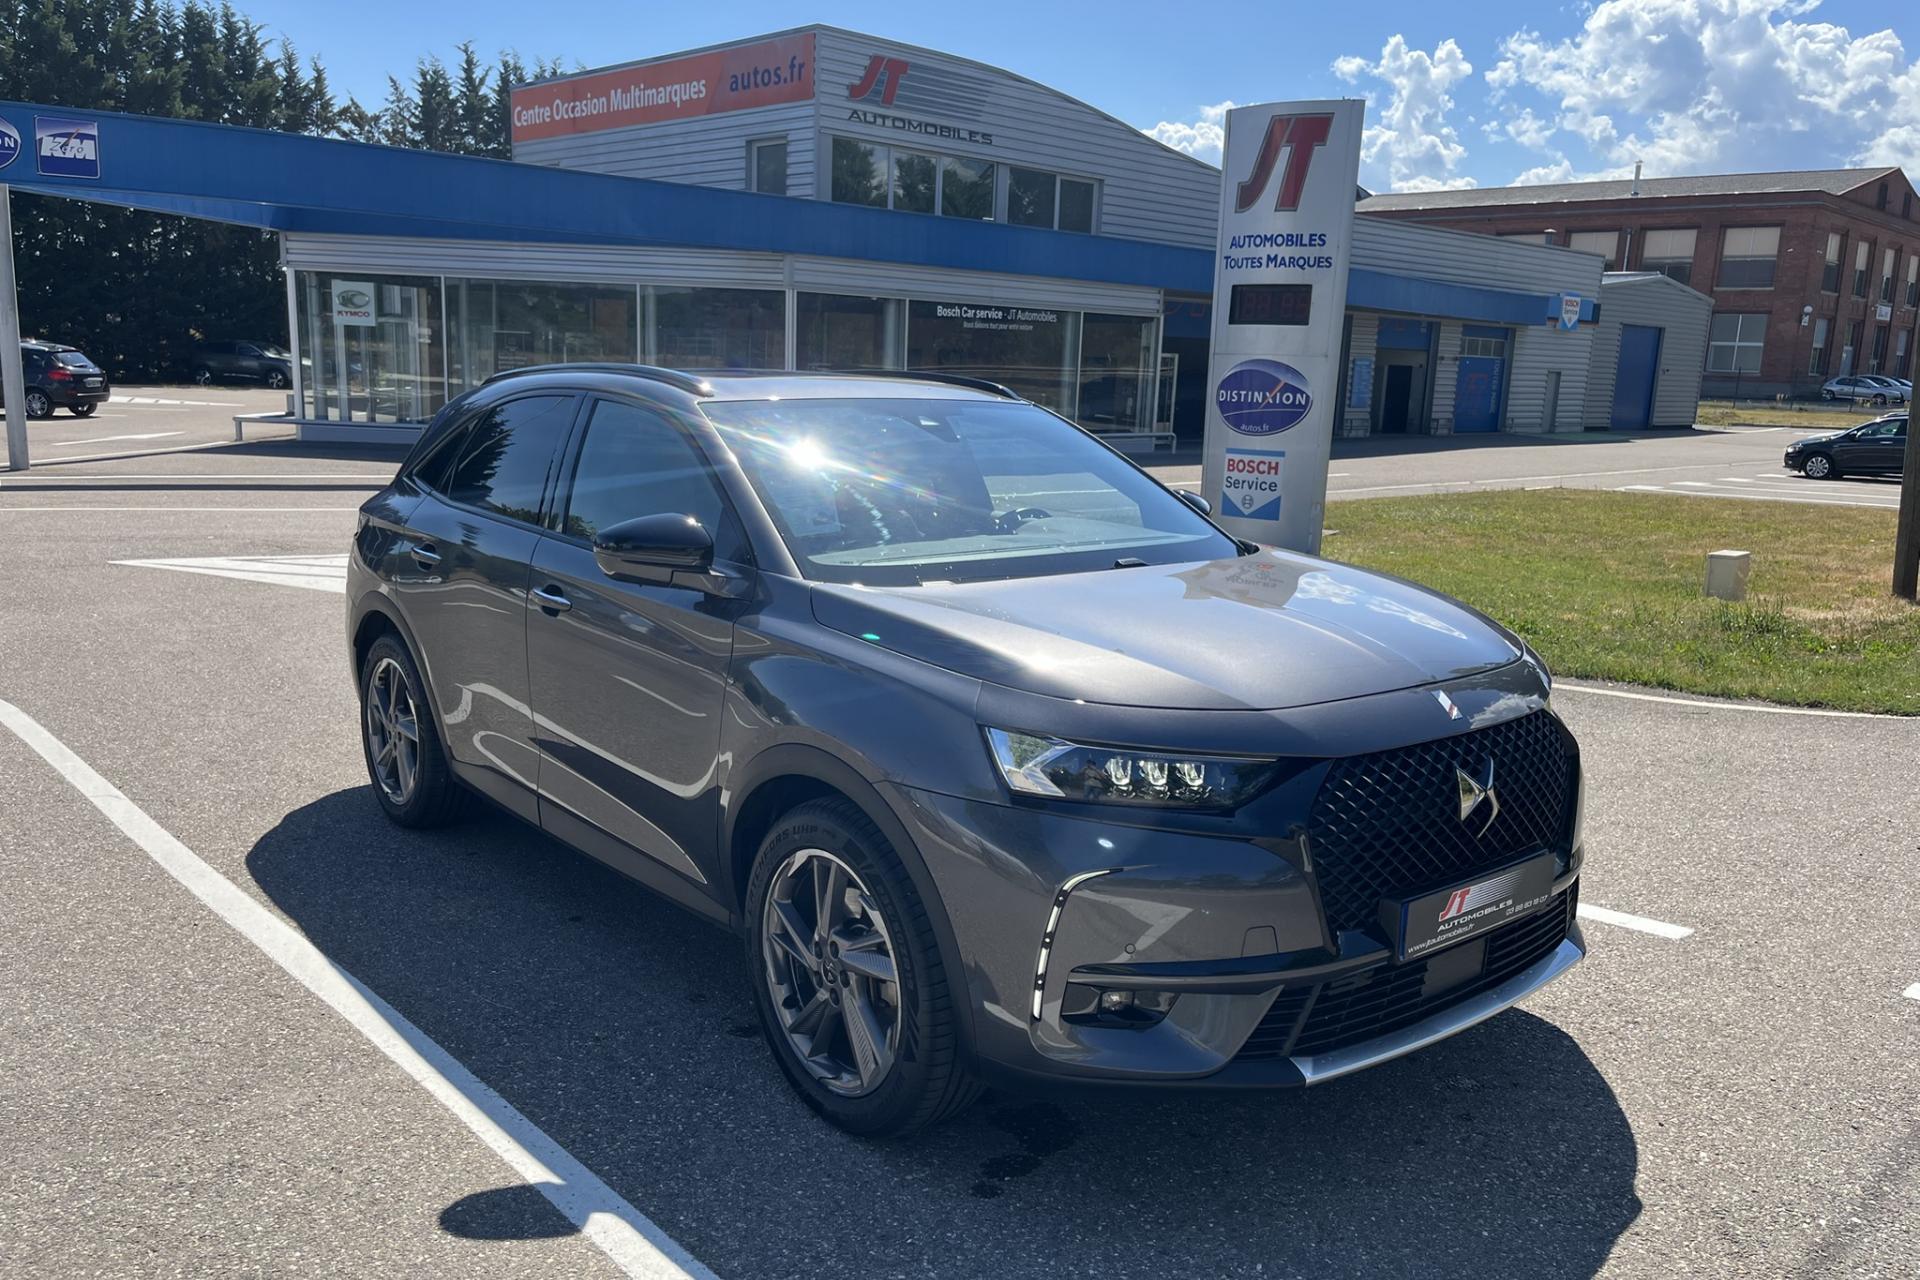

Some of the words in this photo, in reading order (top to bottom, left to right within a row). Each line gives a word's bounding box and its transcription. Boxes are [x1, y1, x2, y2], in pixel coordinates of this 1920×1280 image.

[729, 55, 806, 93] autos.fr
[847, 53, 911, 107] JT
[513, 104, 552, 127] Centre
[553, 93, 607, 121] Occasion
[610, 79, 706, 113] Multimarques
[848, 109, 993, 145] AUTOMOBILES
[1234, 112, 1336, 214] JT
[1229, 233, 1327, 249] AUTOMOBILES
[1223, 255, 1263, 269] TOUTES
[1266, 253, 1333, 270] MARQUES
[336, 310, 370, 318] KYMCO
[936, 305, 961, 318] Bosch
[961, 306, 976, 318] Car
[976, 308, 1003, 319] service
[1007, 310, 1016, 320] JT
[1016, 310, 1058, 323] Automobiles
[1219, 389, 1306, 406] DISTINXION
[1240, 423, 1269, 432] autos.fr
[1226, 458, 1280, 475] BOSCH
[1225, 475, 1278, 492] Service
[1438, 885, 1473, 922] JT
[1437, 898, 1514, 932] AUTOMOBILES
